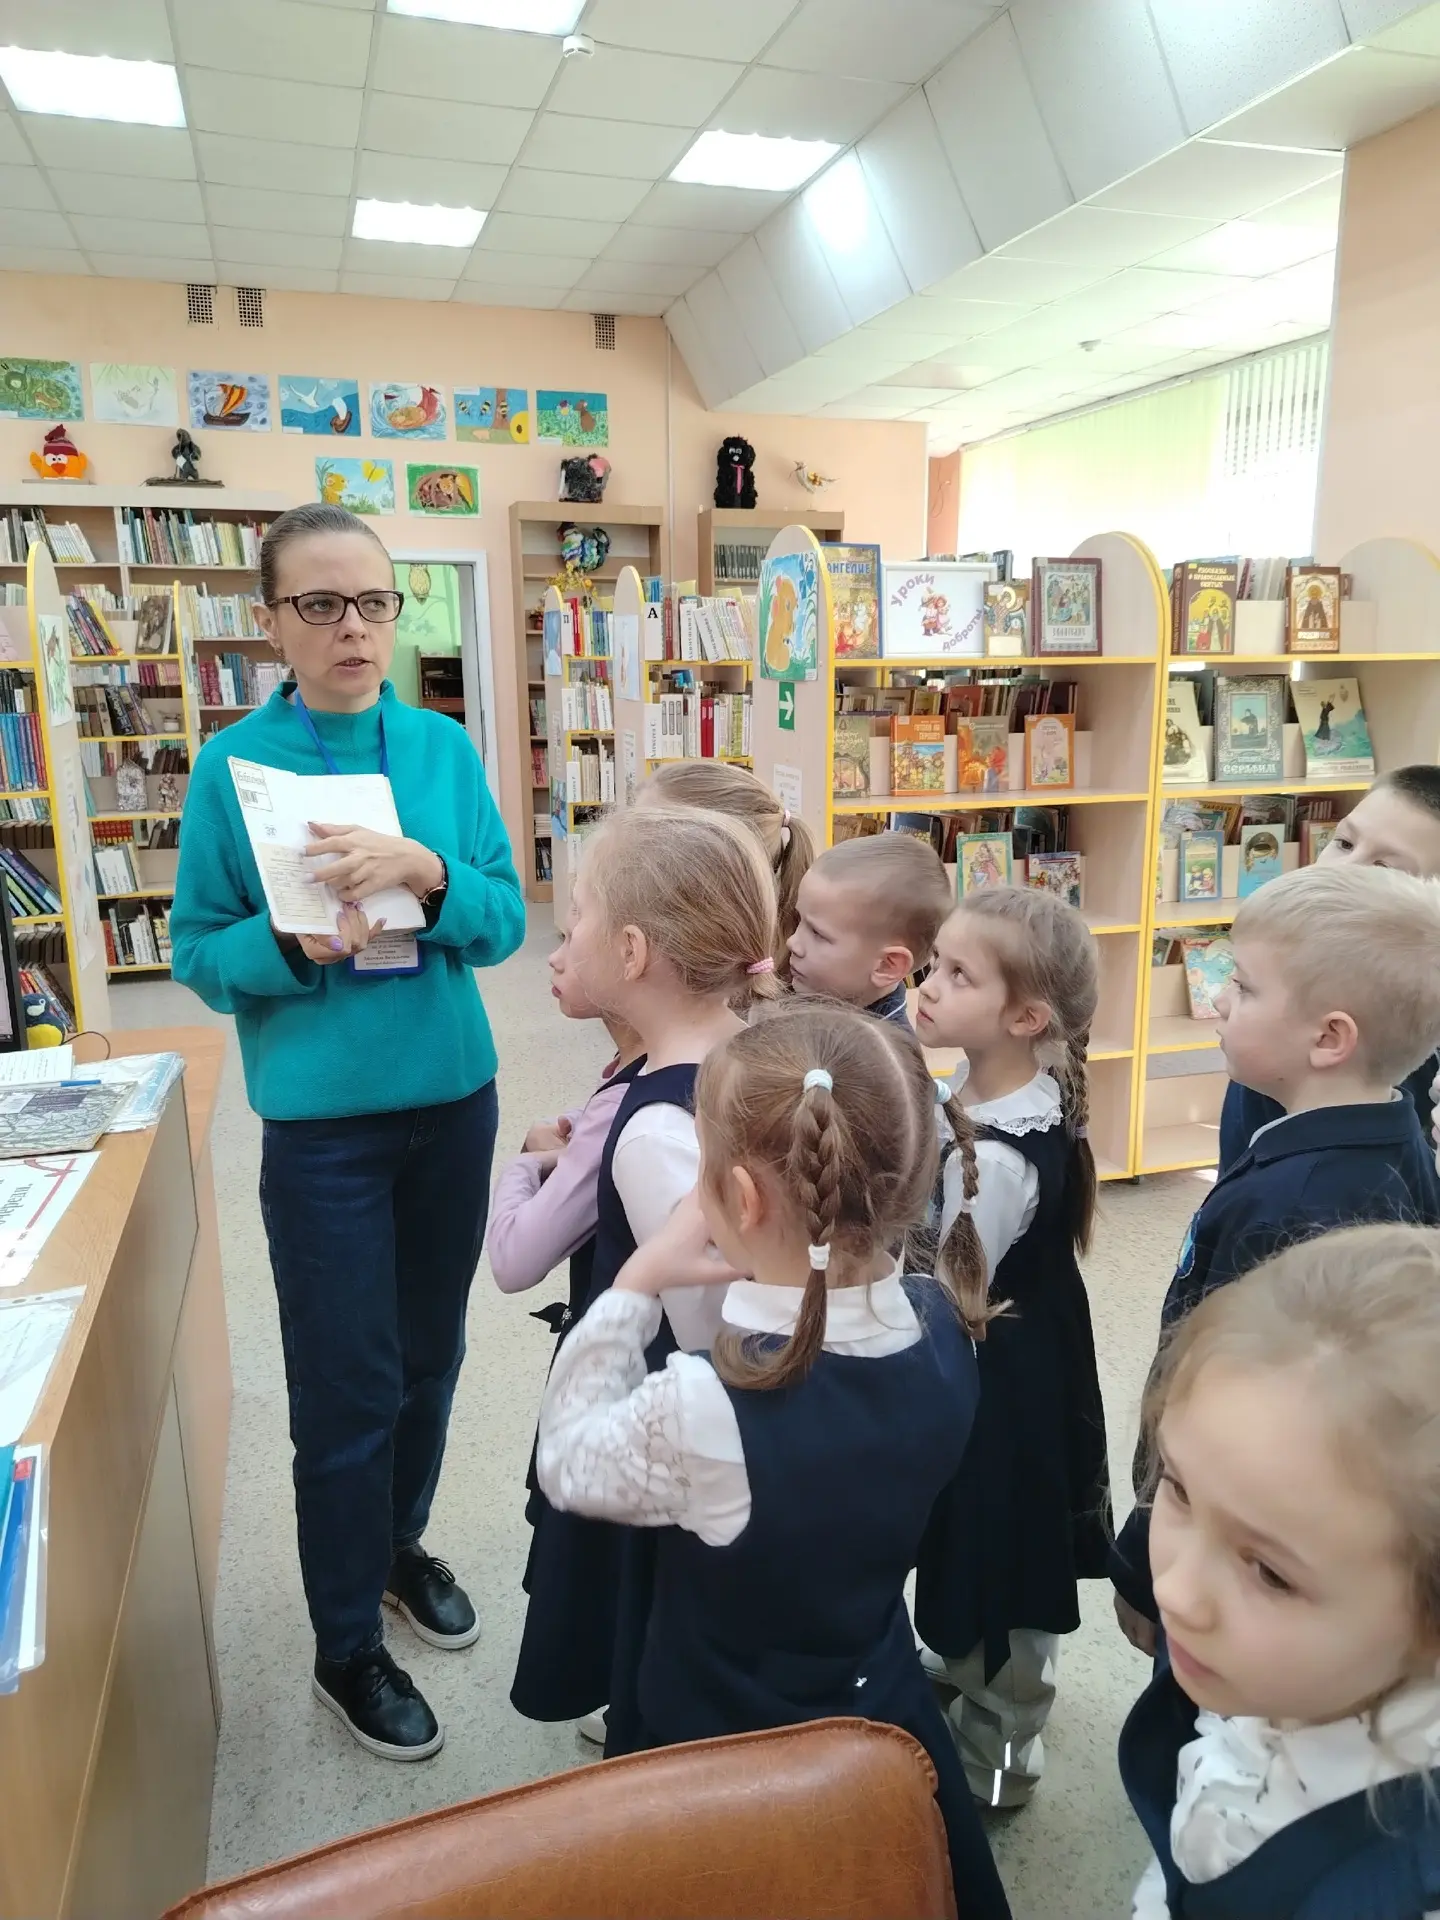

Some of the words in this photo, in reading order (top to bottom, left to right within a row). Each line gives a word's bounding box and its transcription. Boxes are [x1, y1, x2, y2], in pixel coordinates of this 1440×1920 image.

[827, 562, 871, 574] АНГЕЛИЕ
[891, 573, 935, 607] Уроки
[647, 607, 658, 619] А
